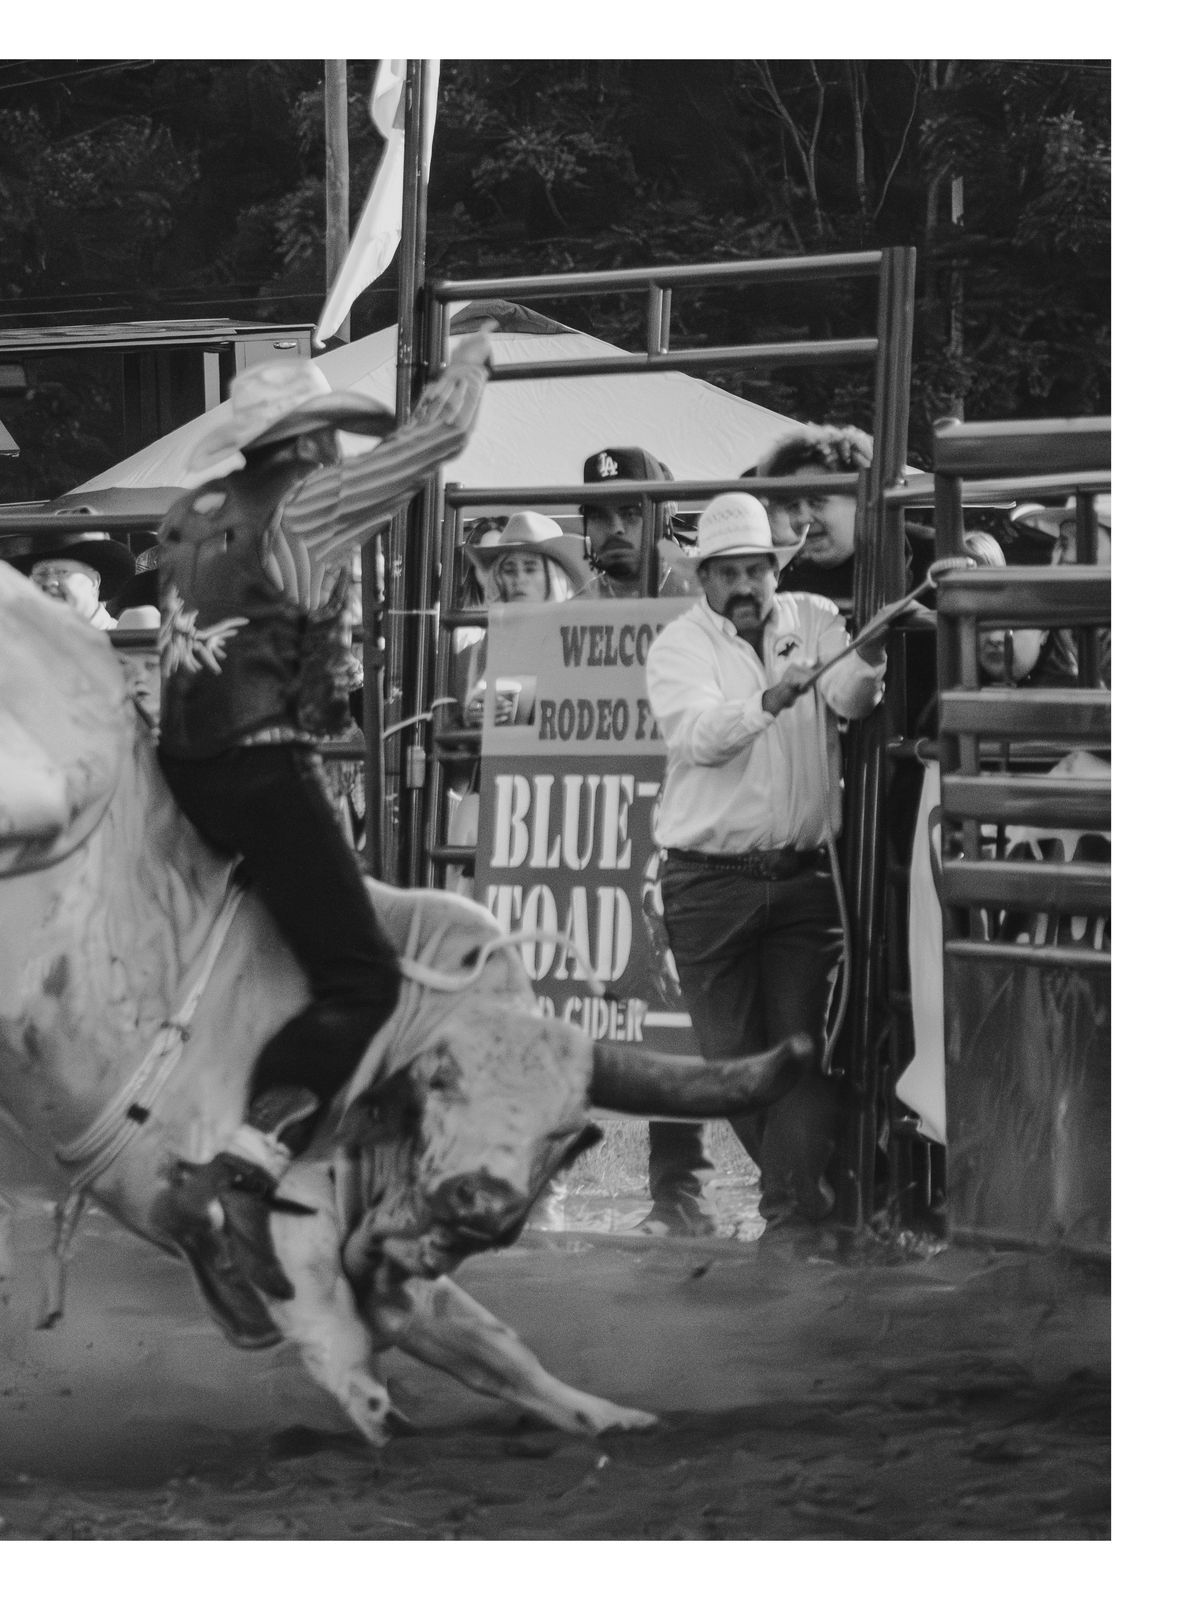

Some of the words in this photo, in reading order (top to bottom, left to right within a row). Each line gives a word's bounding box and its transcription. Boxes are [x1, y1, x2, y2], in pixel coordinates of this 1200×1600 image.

[599, 453, 618, 477] LA
[560, 624, 664, 667] WELCO
[539, 698, 630, 741] RODEO
[490, 774, 634, 870] BLUE
[488, 884, 632, 982] TOAD
[563, 996, 648, 1042] CIDER
